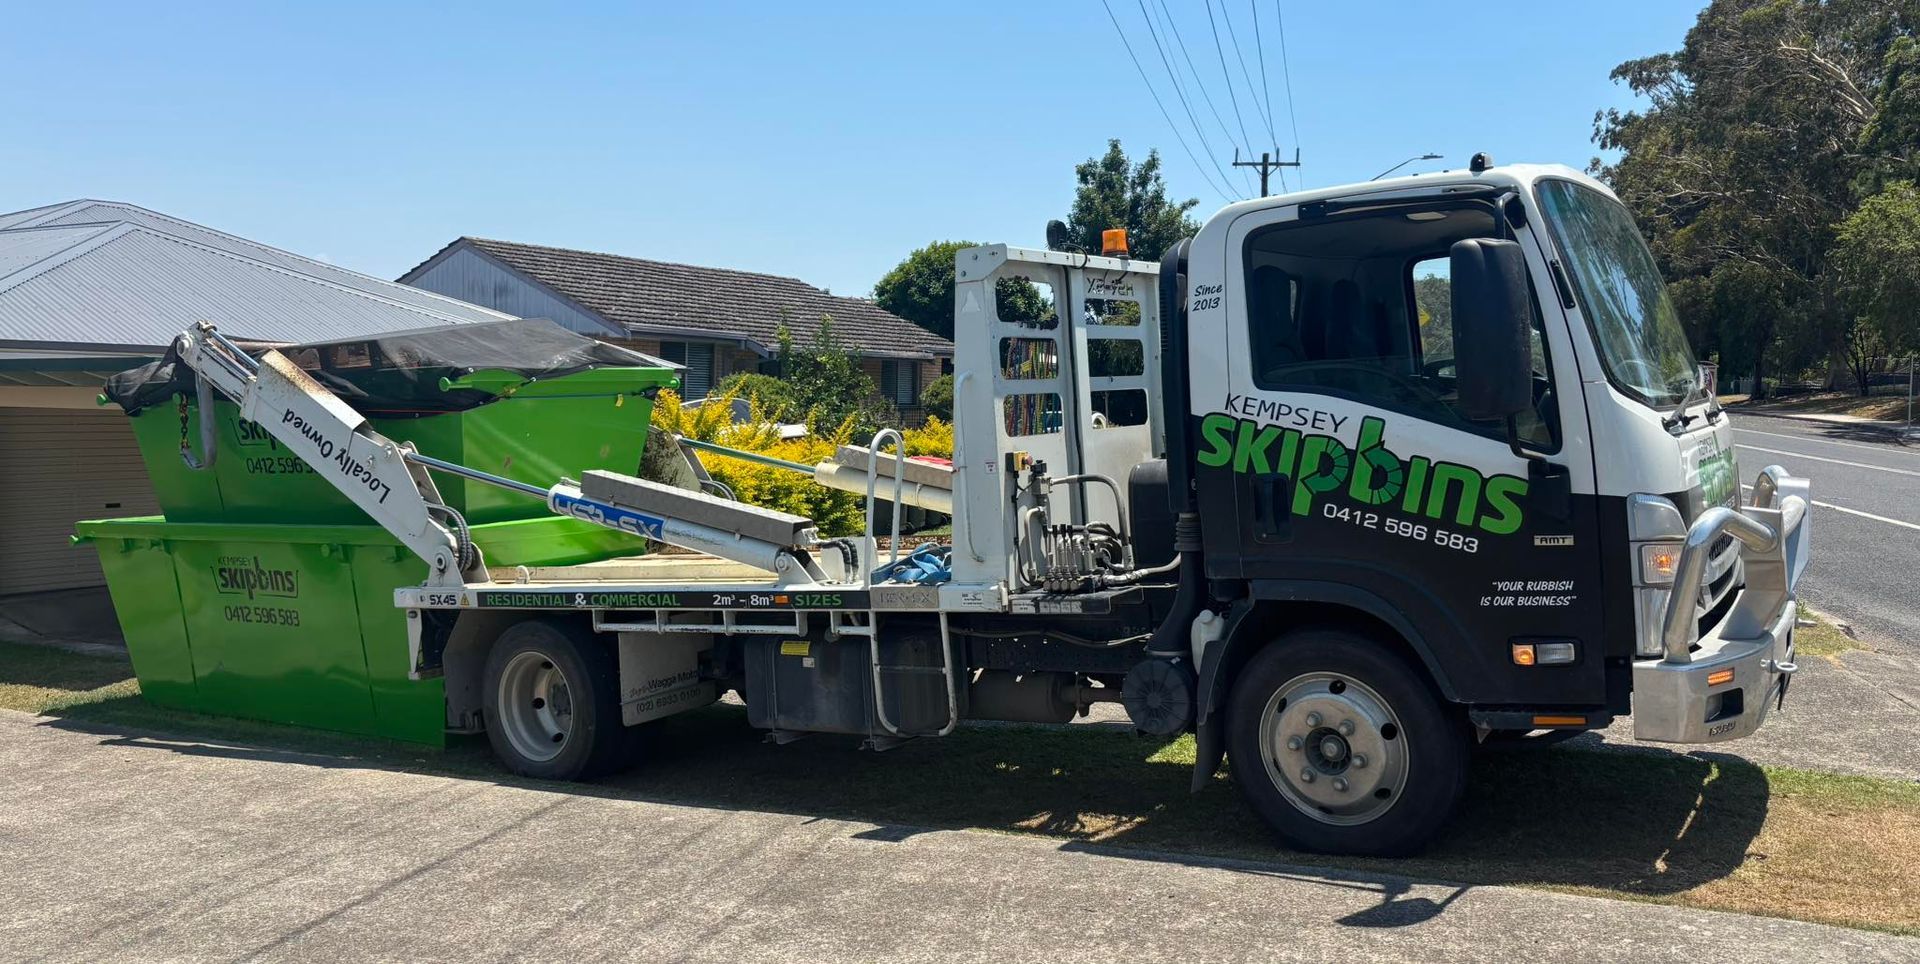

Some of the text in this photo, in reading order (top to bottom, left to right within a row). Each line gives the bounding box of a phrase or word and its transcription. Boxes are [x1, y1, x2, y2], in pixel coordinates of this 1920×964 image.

[1194, 284, 1223, 298] Since
[1192, 297, 1220, 312] 2013
[1224, 393, 1348, 433] KEMPSEY
[282, 408, 391, 504] Locally Owned
[246, 457, 275, 474] 0412
[277, 457, 303, 473] 596
[1322, 503, 1479, 554] 0412 596 583
[1539, 536, 1567, 545] AMT
[1526, 579, 1574, 592] RUBBISH
[429, 594, 457, 606] SX45
[486, 594, 568, 606] RESIDENTIAL
[574, 592, 587, 607] &
[591, 594, 681, 607] COMMERCIAL
[795, 594, 842, 606] SIZES
[1480, 596, 1492, 606] IS
[1493, 596, 1515, 606] OUR
[224, 605, 300, 626] 0412 596 583
